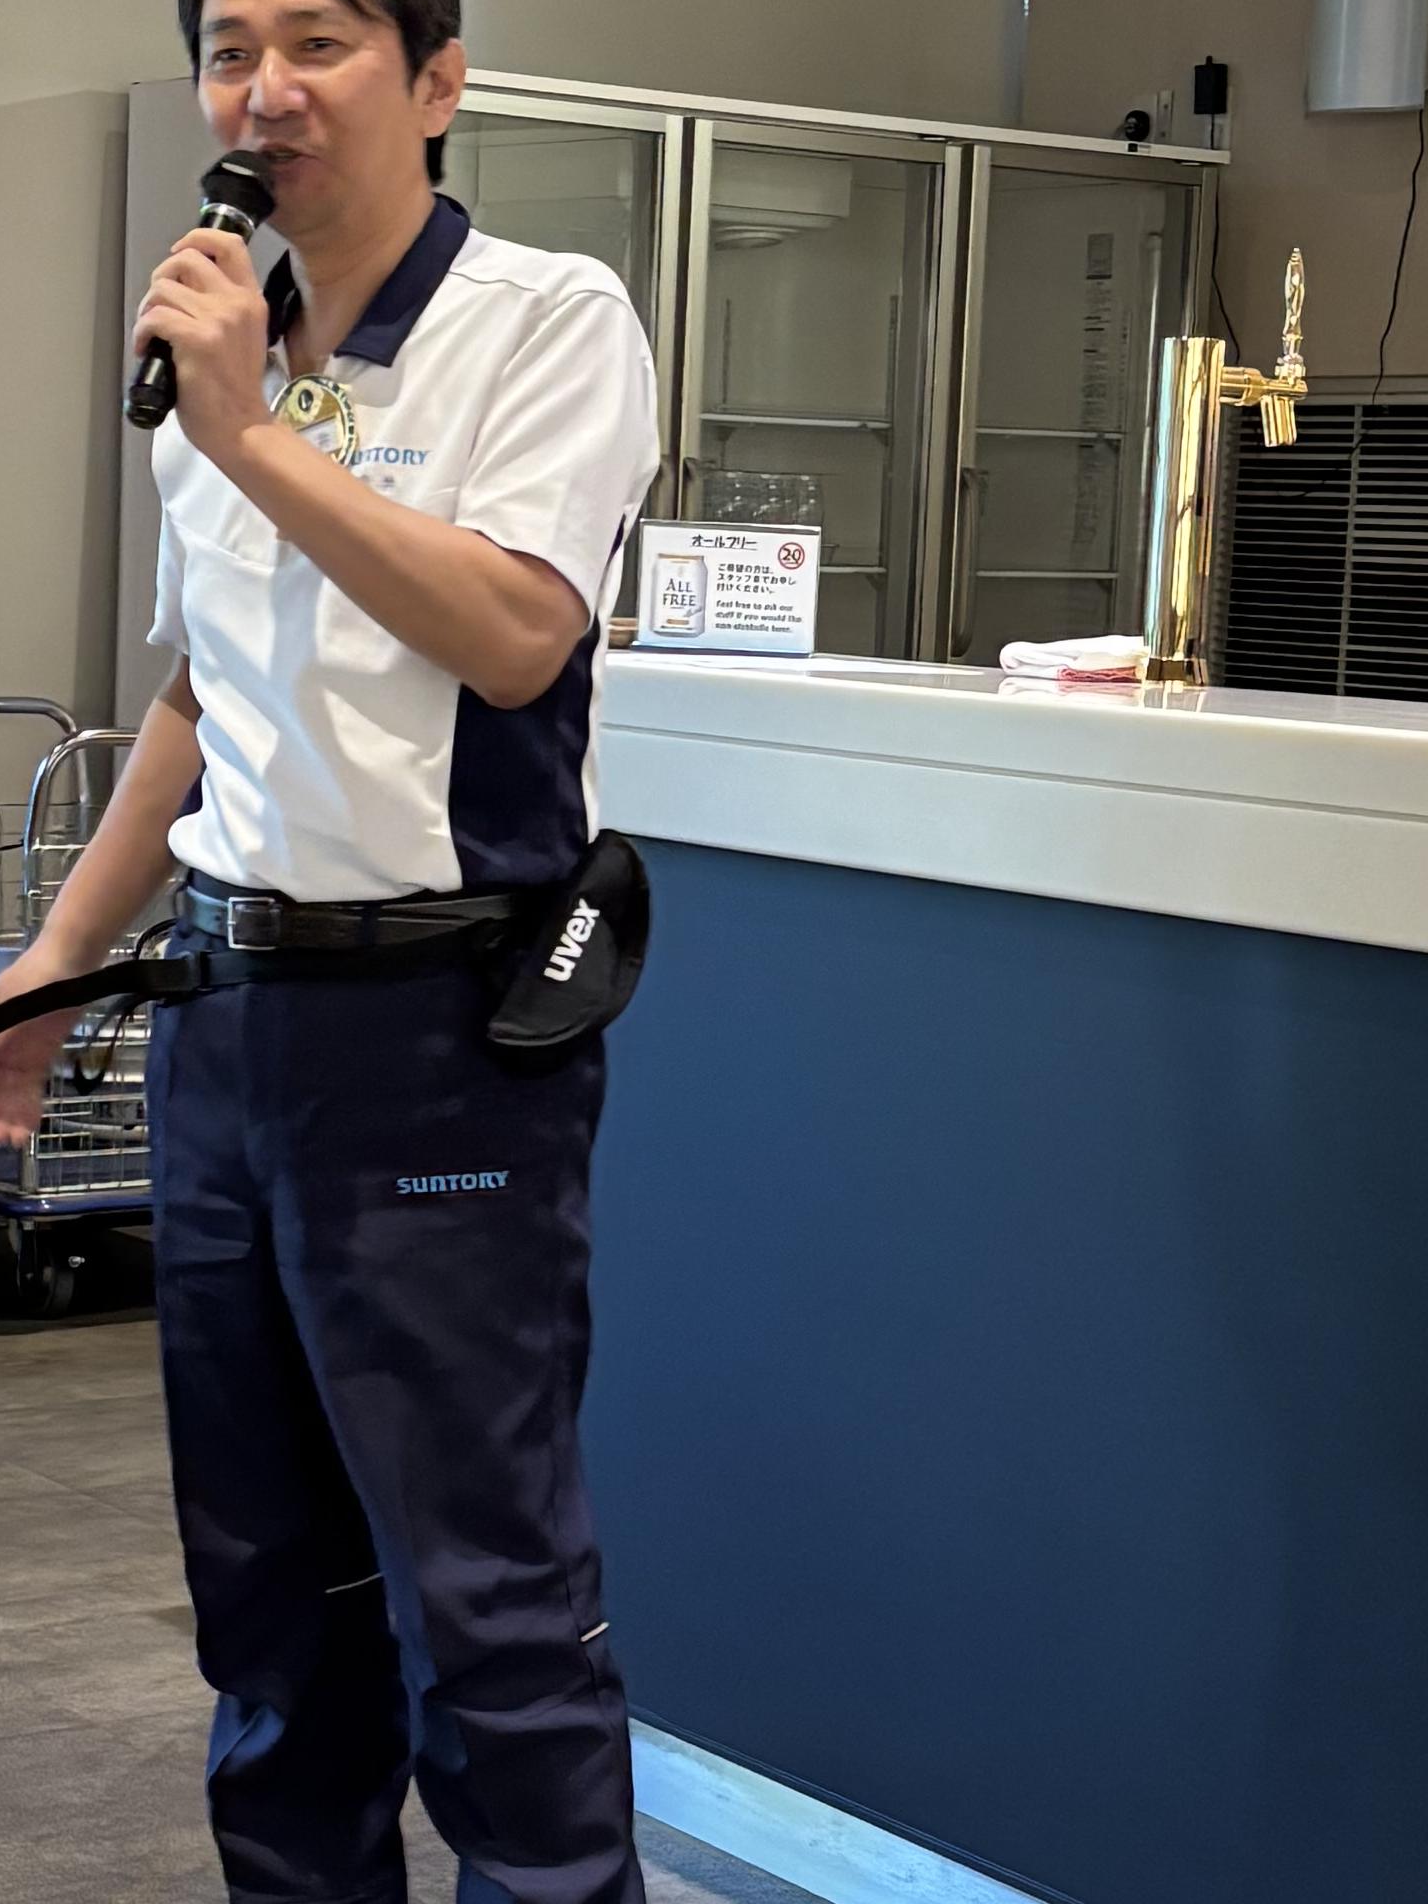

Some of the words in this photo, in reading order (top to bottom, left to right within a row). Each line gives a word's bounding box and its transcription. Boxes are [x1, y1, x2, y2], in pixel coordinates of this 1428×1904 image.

[692, 534, 757, 549] オールフリー
[665, 578, 693, 593] ALL
[662, 593, 697, 607] FREE
[543, 898, 600, 982] uvex
[396, 1170, 510, 1194] SUNTORY
